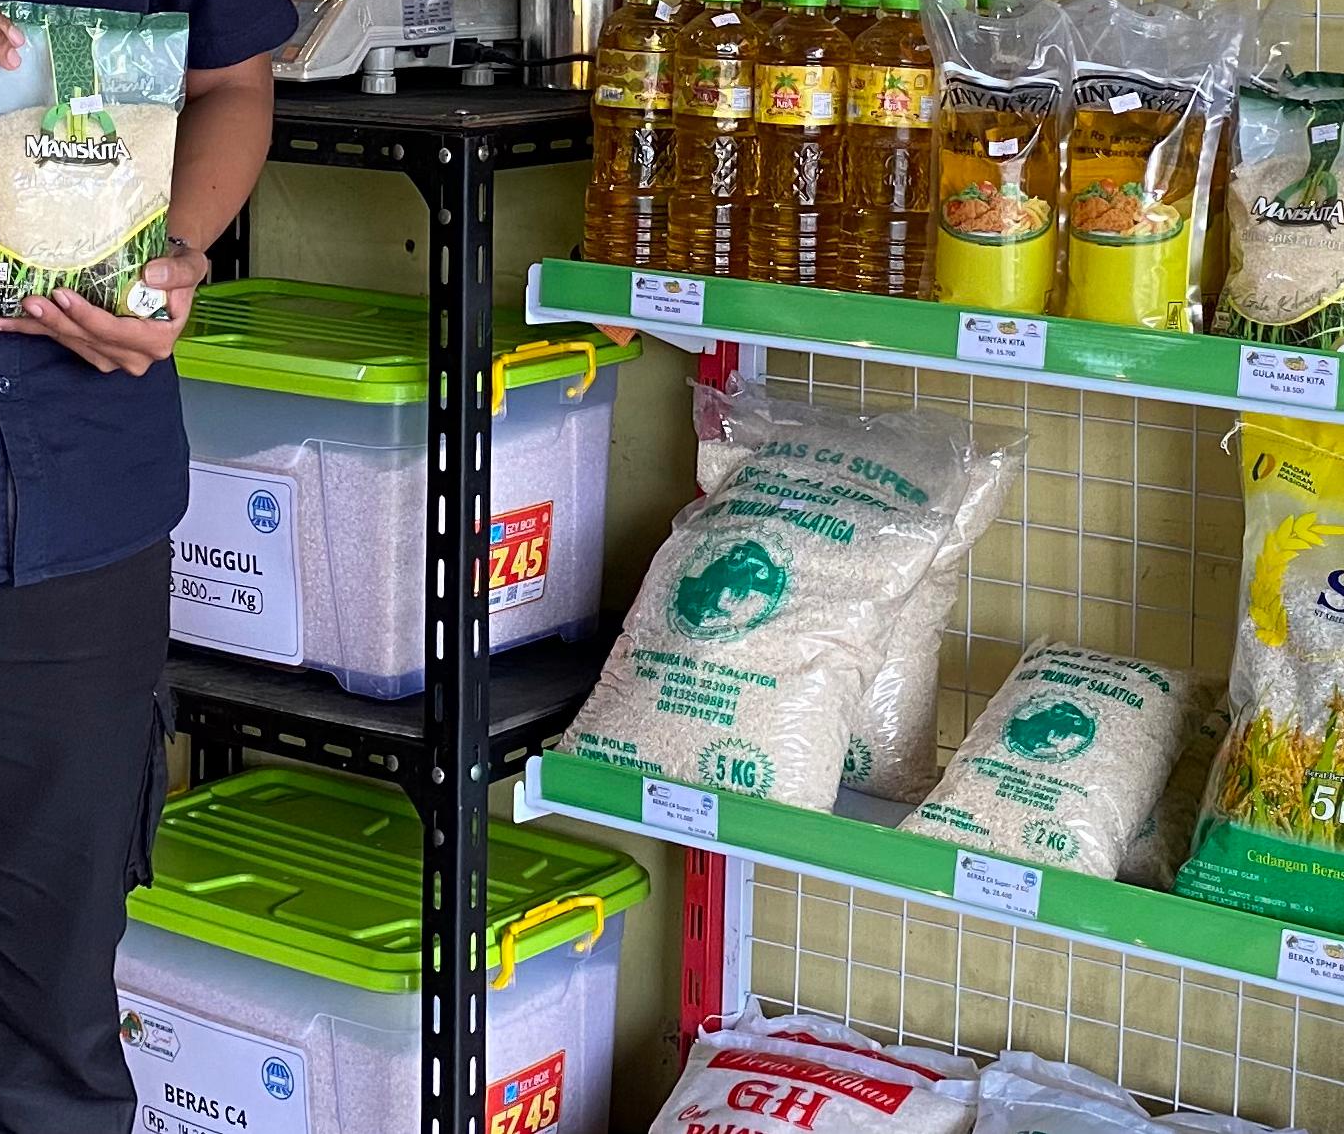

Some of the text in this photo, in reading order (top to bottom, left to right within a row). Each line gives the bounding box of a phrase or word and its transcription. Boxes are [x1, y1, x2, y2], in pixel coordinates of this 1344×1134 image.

[1252, 369, 1326, 387] GULA MANIS KITA
[815, 448, 929, 507] C4 SUPER
[753, 482, 839, 506] RODUKSI
[521, 518, 536, 530] BOX
[782, 509, 856, 545] SALATIGA
[181, 542, 263, 575] UNGGUL
[490, 537, 544, 589] Z 45
[231, 589, 255, 611] /Kg
[636, 667, 660, 681] Telp.
[718, 666, 778, 689] SALATIGA
[1087, 679, 1144, 711] SALATIGA
[602, 738, 637, 754] POLES
[612, 754, 662, 774] PEMUTIH
[716, 755, 756, 787] 5 KG
[1046, 775, 1088, 798] SALATIGA
[1311, 785, 1336, 821] 5
[949, 816, 990, 836] PEMUTIH
[1035, 828, 1067, 851] 2 KG
[1247, 850, 1308, 873] Cadangan
[1288, 951, 1314, 965] BERAS
[1316, 957, 1337, 969] SPHP
[534, 1069, 549, 1086] BOX
[164, 1083, 219, 1119] BERAS
[225, 1106, 247, 1129] C4
[524, 1086, 556, 1132] 45
[726, 1080, 832, 1131] GH
[149, 1111, 168, 1133] Rp.
